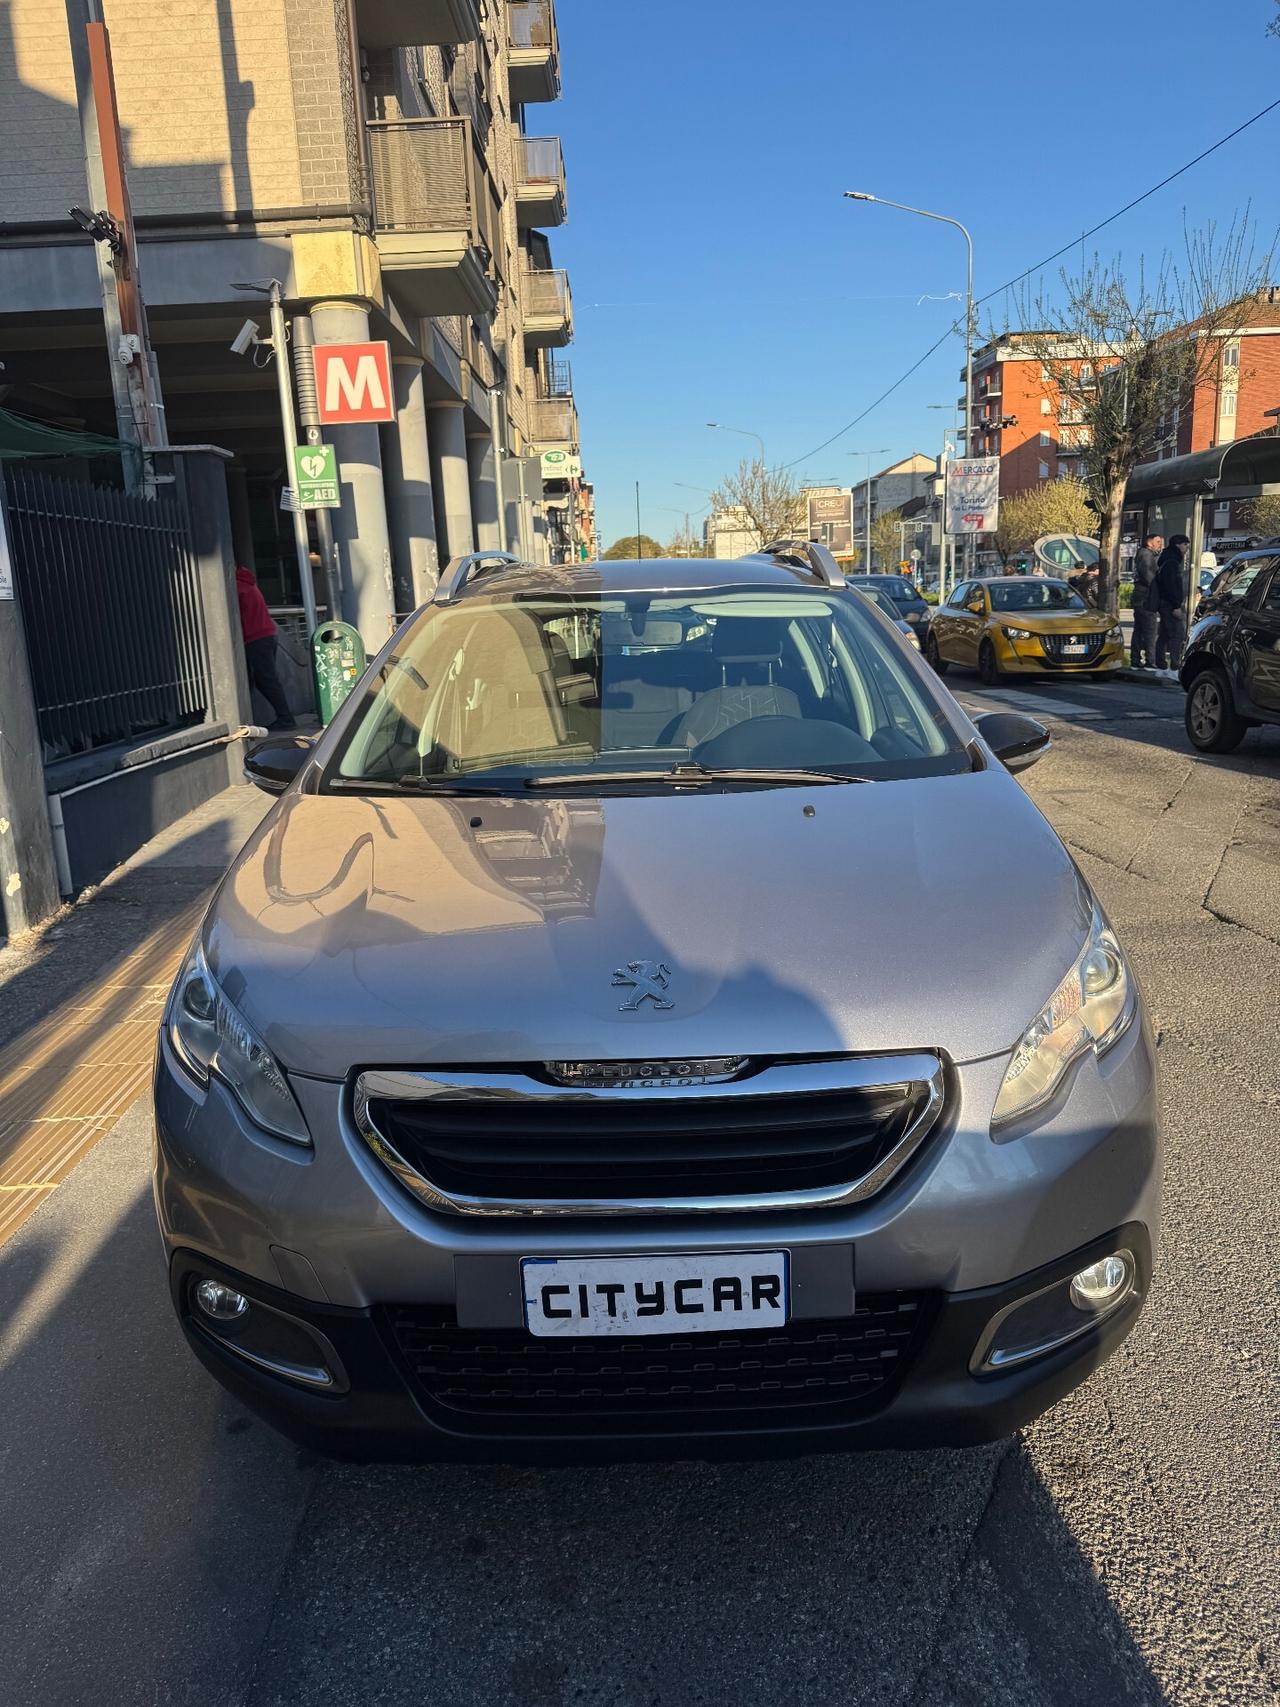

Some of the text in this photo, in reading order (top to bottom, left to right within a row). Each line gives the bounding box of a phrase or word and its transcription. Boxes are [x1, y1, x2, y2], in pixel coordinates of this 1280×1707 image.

[325, 355, 387, 411] M
[314, 488, 336, 500] AED
[960, 495, 985, 504] Torino
[583, 1063, 710, 1077] PEUGEOT
[541, 1275, 781, 1318] CITYCAR
